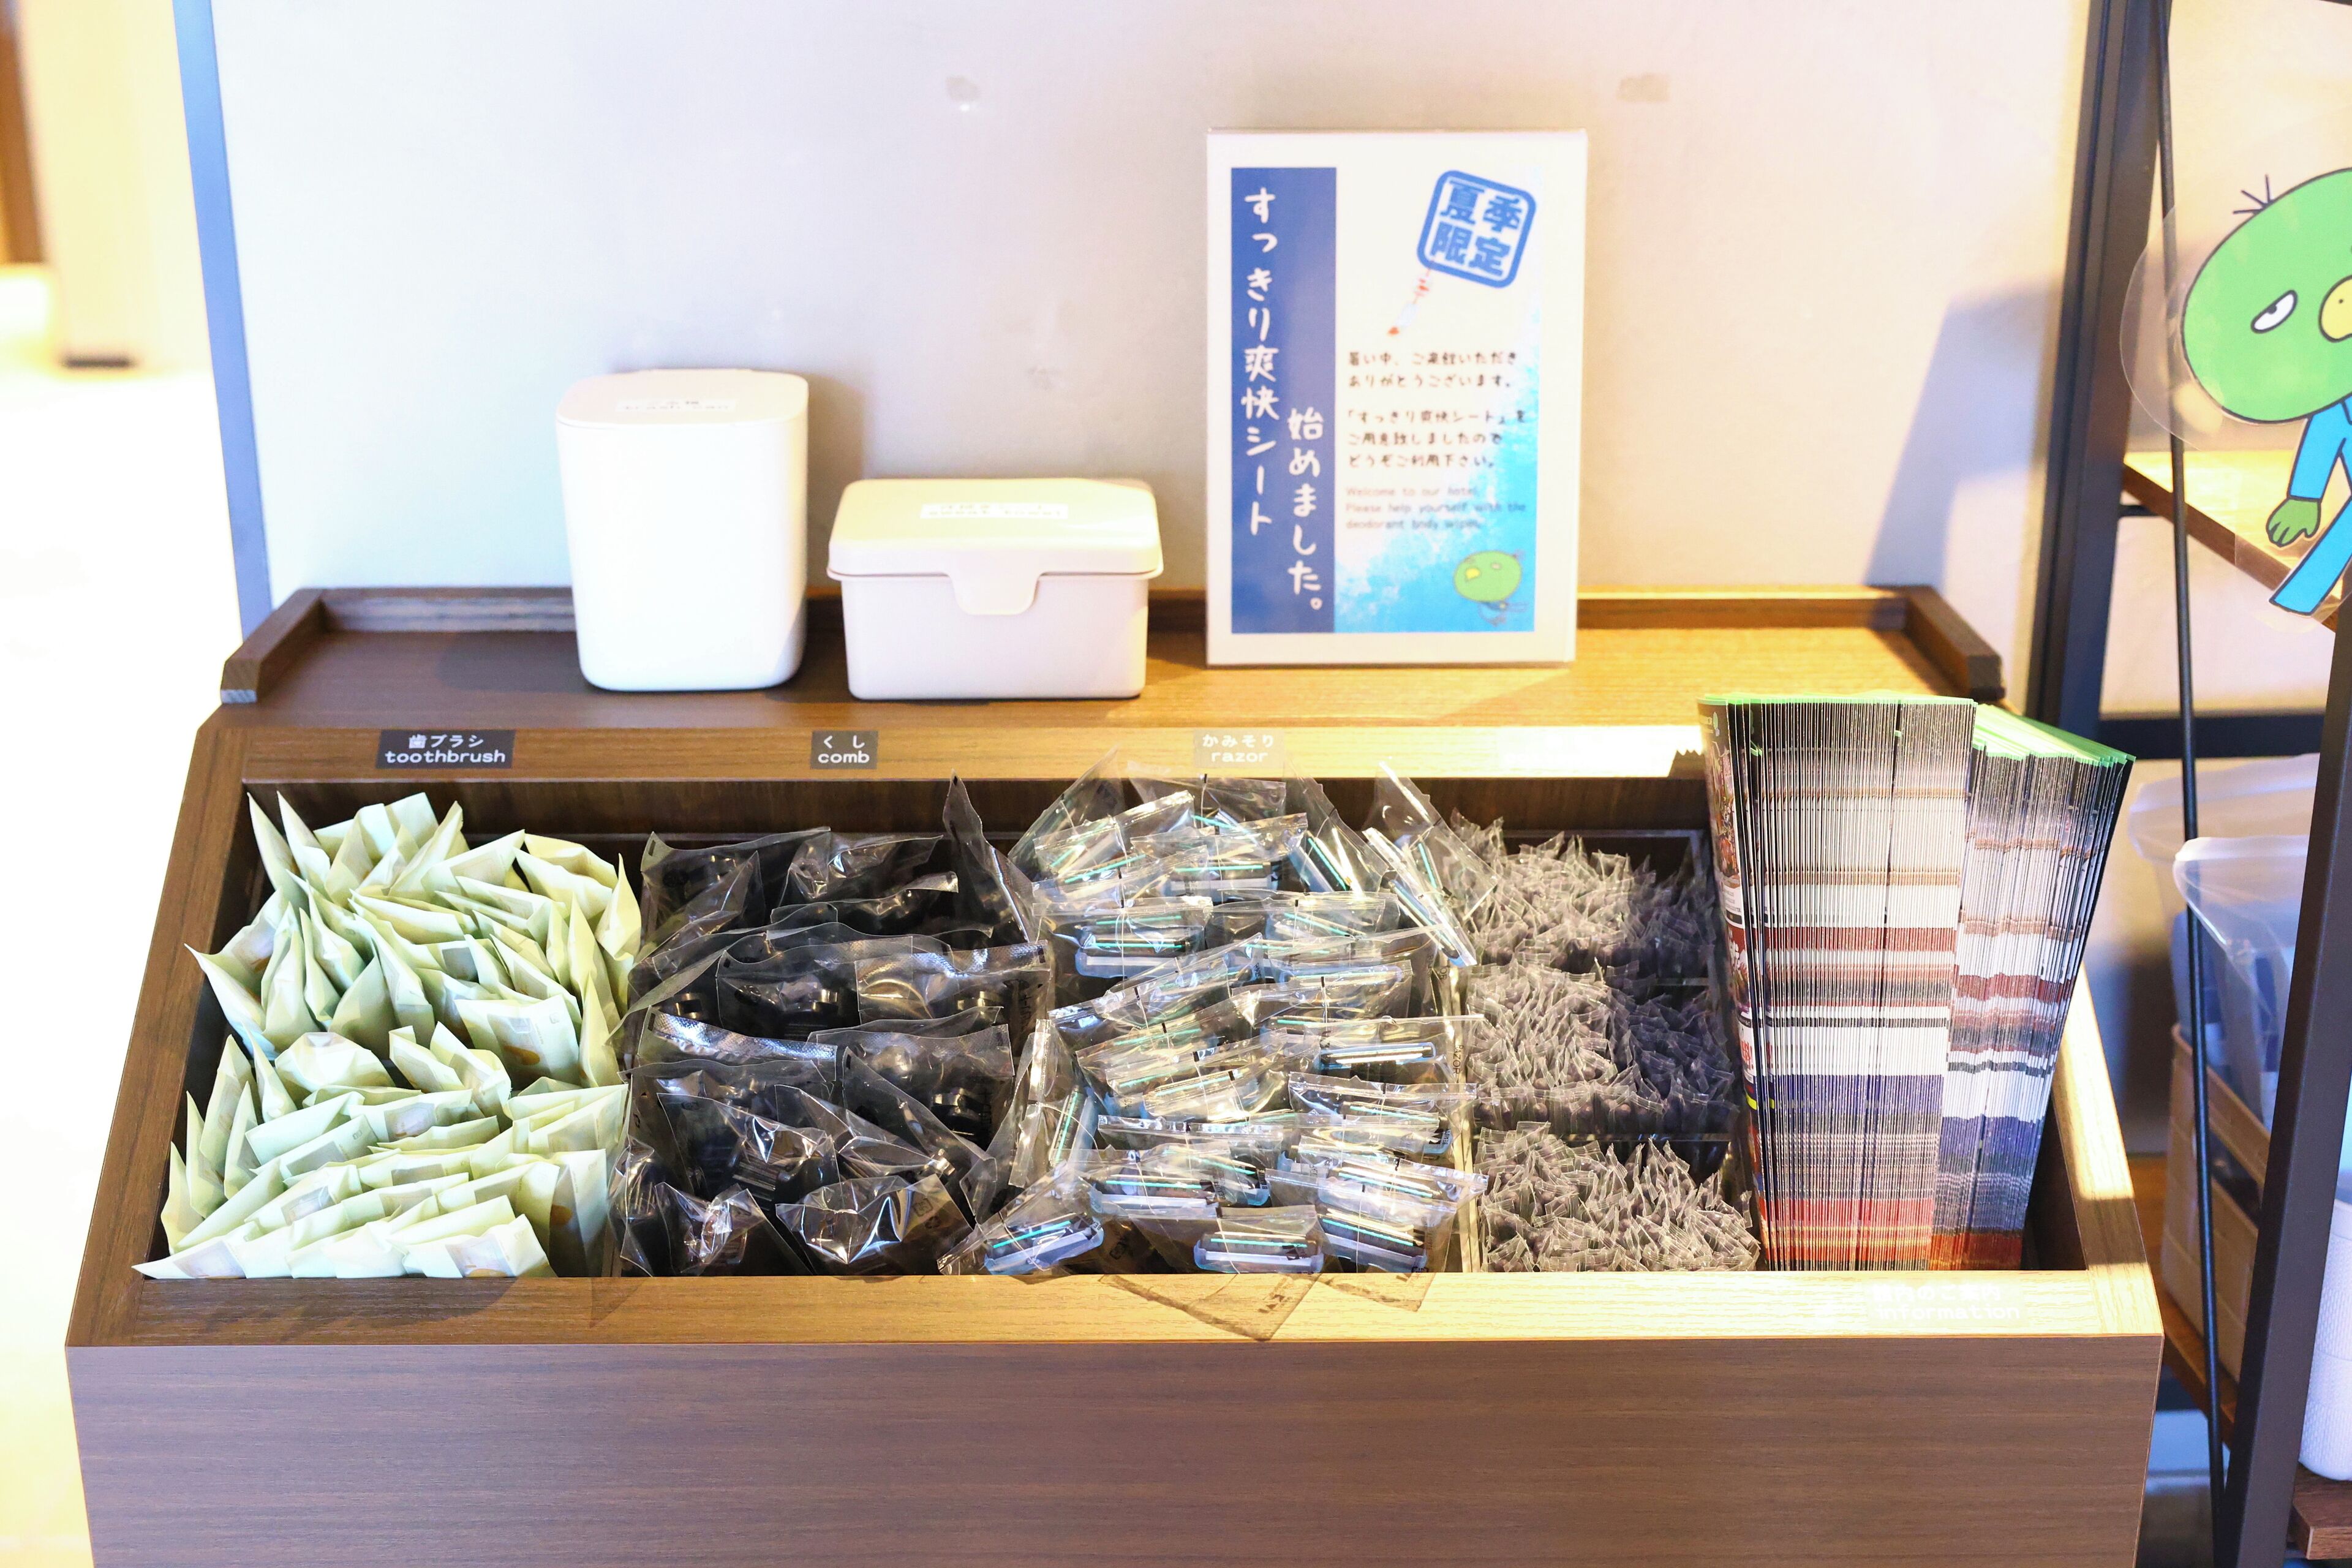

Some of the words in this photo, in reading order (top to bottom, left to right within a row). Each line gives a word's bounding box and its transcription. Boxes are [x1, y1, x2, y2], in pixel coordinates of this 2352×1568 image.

[1439, 179, 1523, 233] 夏季
[1430, 221, 1511, 276] 限定
[1241, 187, 1280, 535] すっきり爽快シート
[1287, 407, 1325, 611] 始めました。
[408, 734, 484, 748] 歯ブラシ
[823, 735, 865, 748] くし
[1202, 734, 1274, 748] かみそり
[385, 750, 505, 763] toothbrush
[818, 750, 870, 763] comb
[1211, 752, 1268, 763] razor
[1877, 1303, 2020, 1319] information
